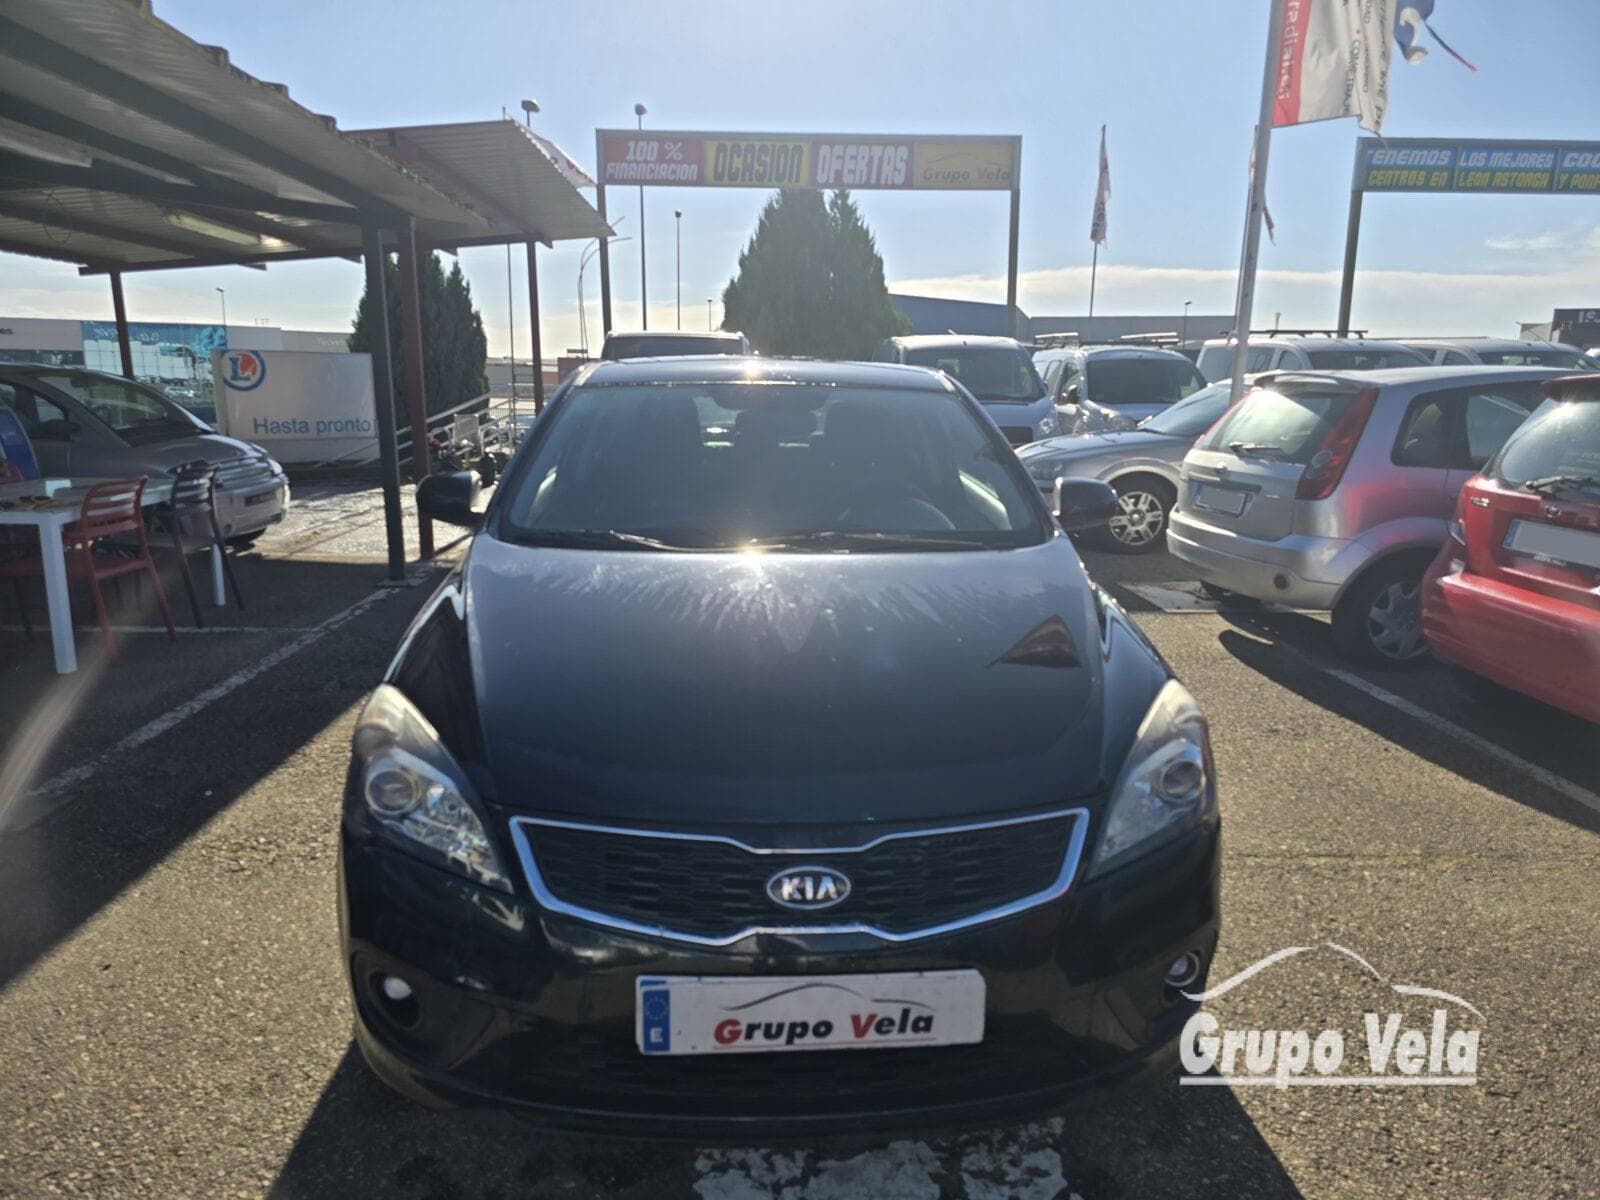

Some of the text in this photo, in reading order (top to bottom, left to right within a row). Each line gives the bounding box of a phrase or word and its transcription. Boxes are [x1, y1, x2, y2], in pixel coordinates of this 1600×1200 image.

[626, 141, 683, 161] 100 %
[1459, 151, 1487, 167] LOS
[1488, 152, 1554, 168] MEJORES
[606, 162, 698, 181] FINANCIACION
[714, 144, 803, 183] OCASION
[816, 144, 908, 185] OFERTAS
[923, 167, 1010, 183] Grupo Vela
[1368, 170, 1426, 187] CENTROS
[1429, 171, 1448, 187] EN
[1459, 171, 1490, 187] LEON
[253, 417, 371, 435] Hasta pronto
[781, 876, 839, 900] KIA
[650, 1027, 664, 1043] E
[714, 1009, 934, 1045] Grupo Vela
